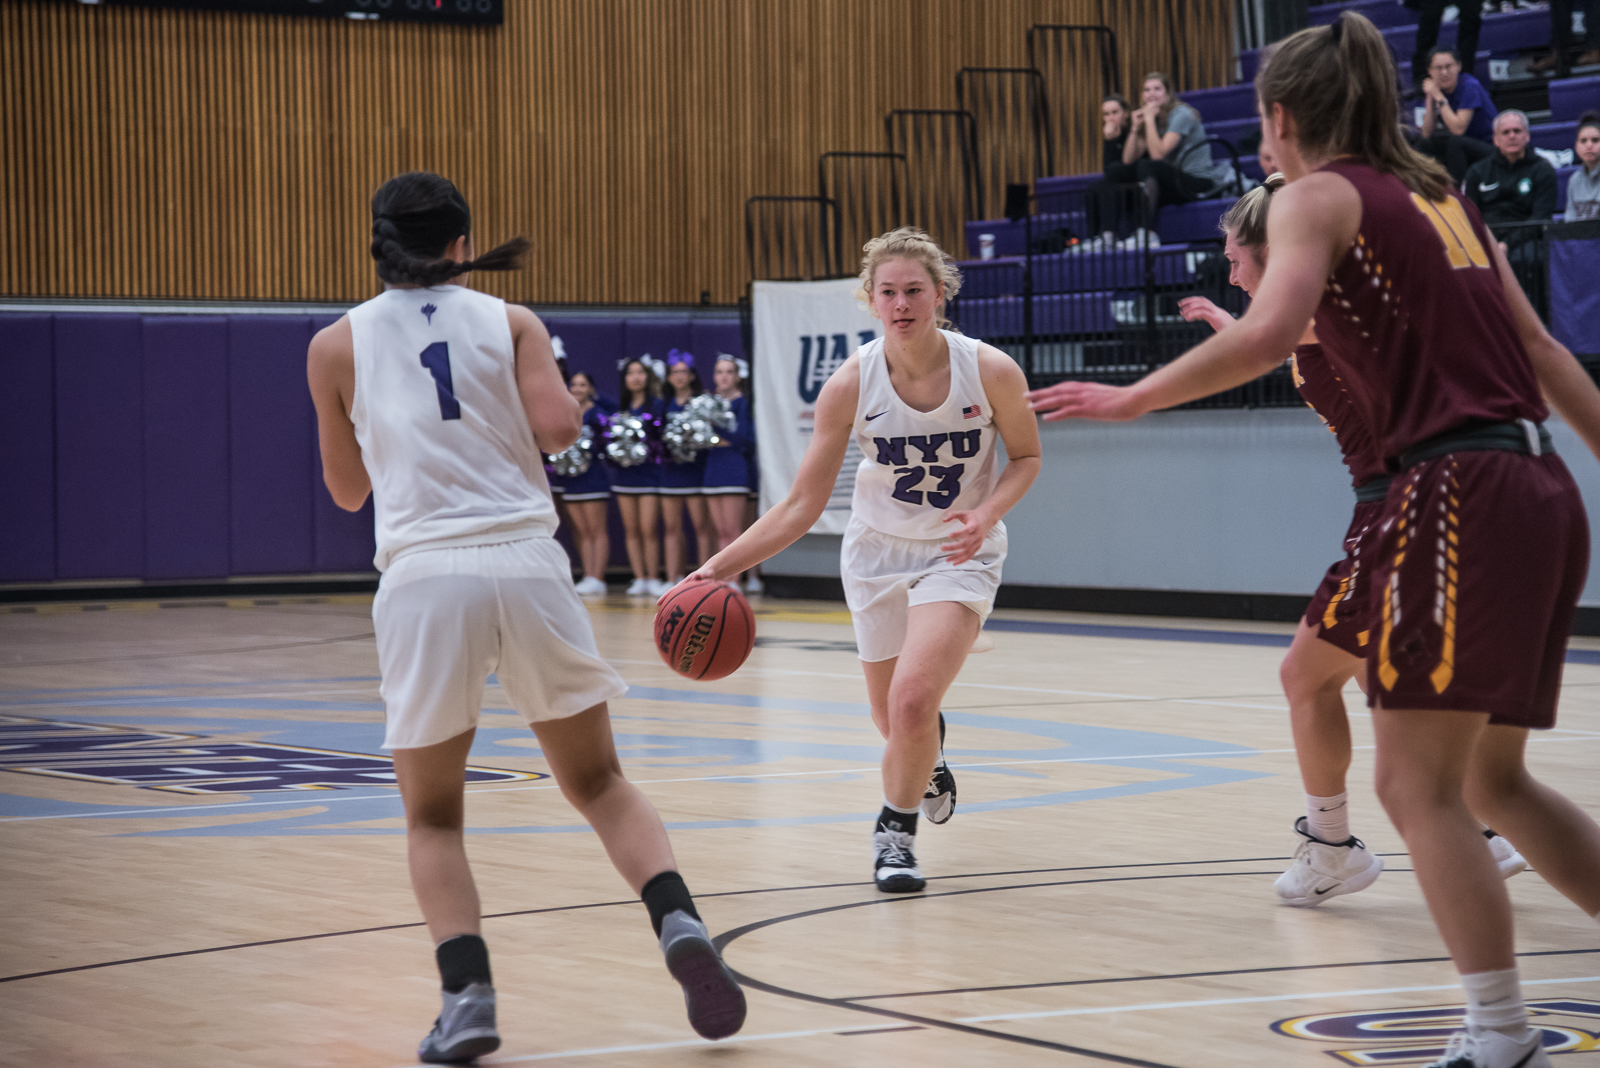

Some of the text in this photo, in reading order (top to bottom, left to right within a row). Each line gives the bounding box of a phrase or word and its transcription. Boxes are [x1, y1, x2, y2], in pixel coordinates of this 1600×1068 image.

[419, 341, 461, 421] 1
[872, 428, 982, 466] NYU
[891, 463, 965, 509] 23
[678, 613, 717, 673] Wilson
